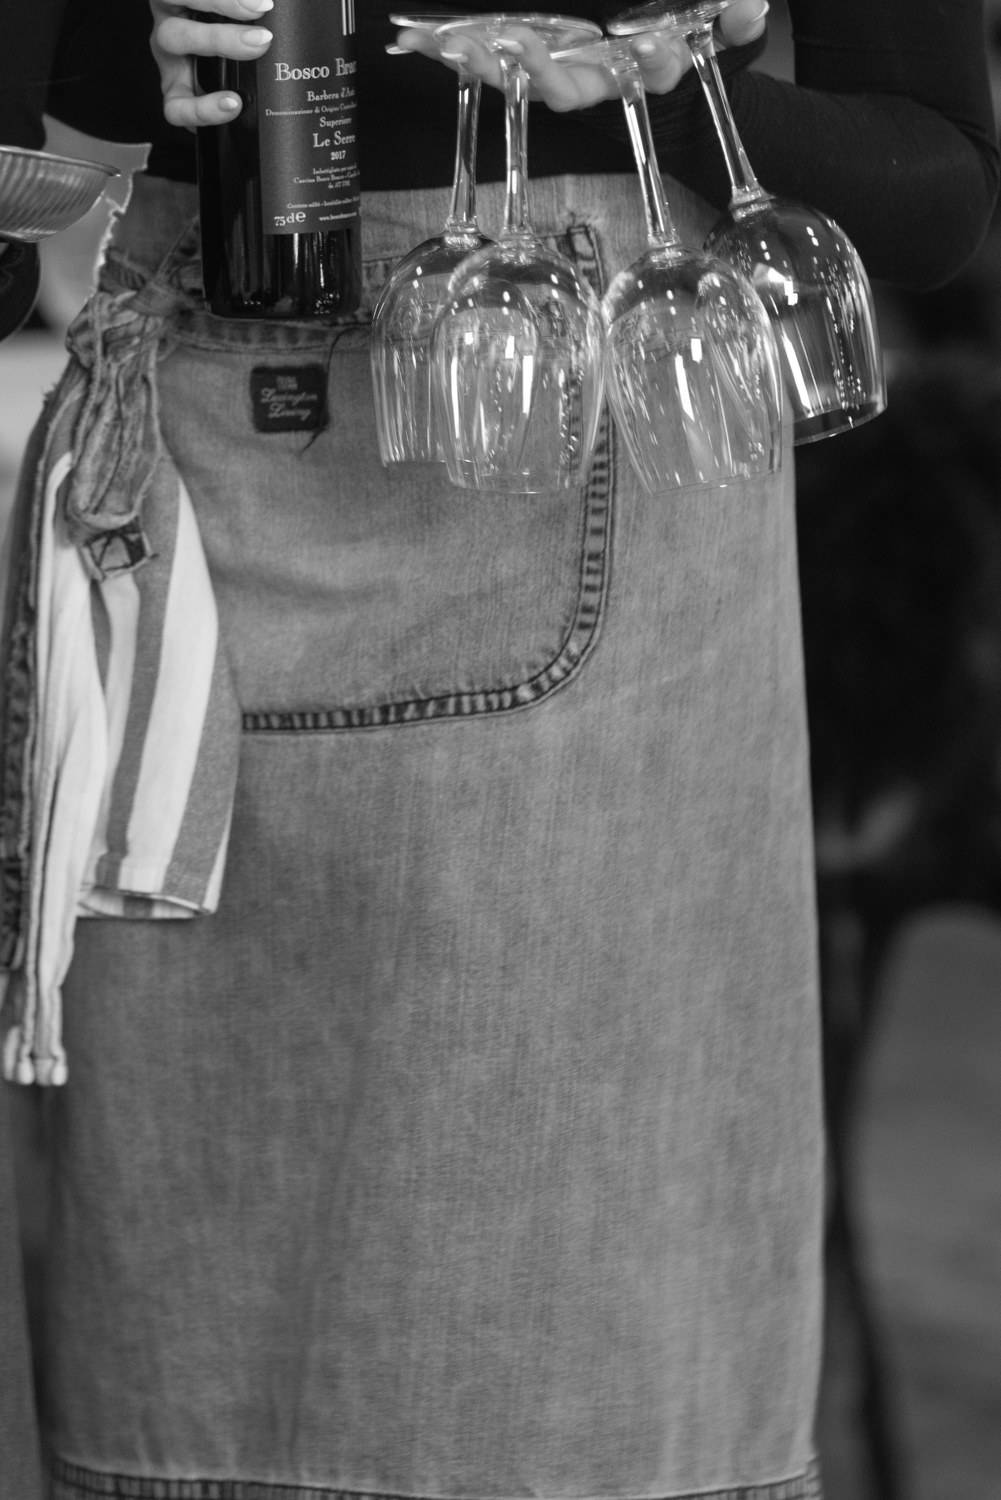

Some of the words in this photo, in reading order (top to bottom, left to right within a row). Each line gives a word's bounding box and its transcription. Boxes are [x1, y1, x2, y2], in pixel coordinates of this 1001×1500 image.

[275, 62, 330, 81] Bosco
[307, 89, 340, 102] Barbera
[312, 133, 331, 148] Le
[330, 150, 346, 160] 2017
